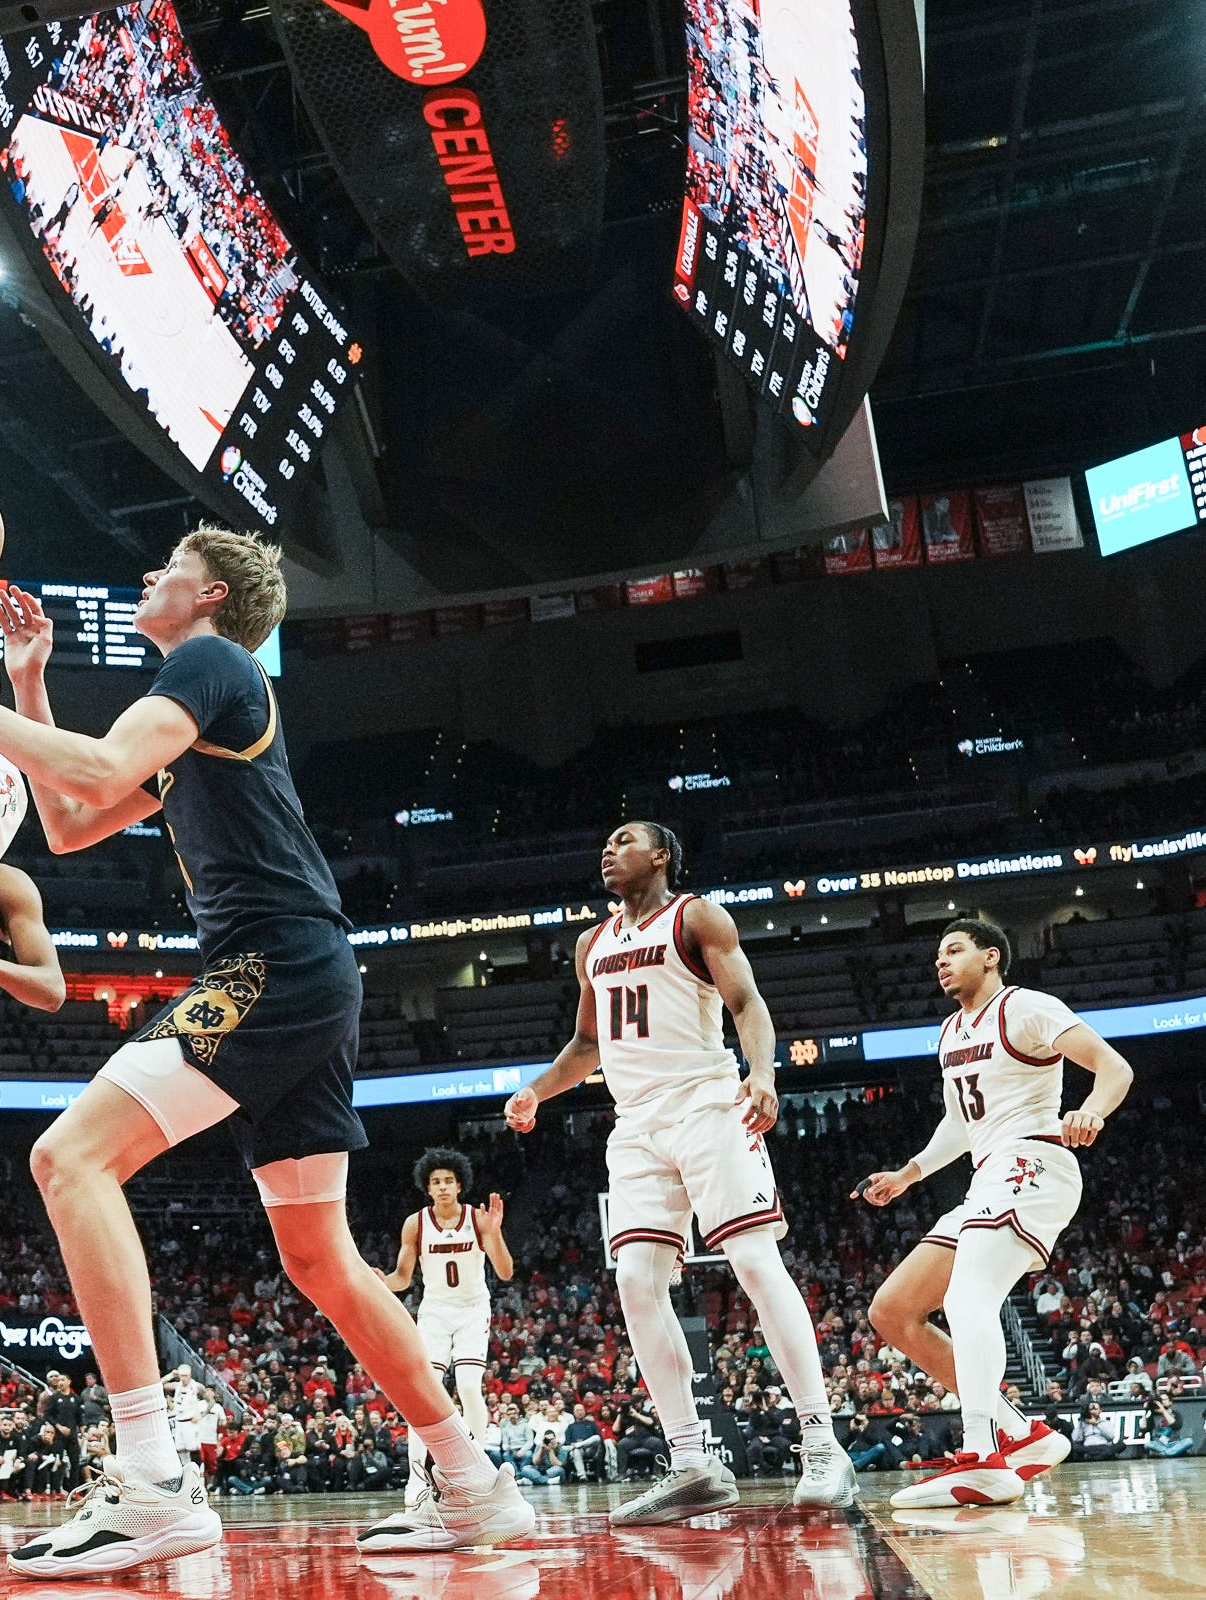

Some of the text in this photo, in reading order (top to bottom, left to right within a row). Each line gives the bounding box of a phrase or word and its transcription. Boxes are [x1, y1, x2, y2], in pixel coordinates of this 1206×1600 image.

[389, 0, 467, 78] um!
[423, 95, 516, 257] CENTER
[681, 209, 699, 276] LOUISVILLE
[300, 280, 348, 346] NOTRE DAME
[695, 290, 708, 315] PPP
[292, 312, 310, 335] PPP
[714, 311, 728, 337] EFG
[782, 313, 796, 343] 16.7
[278, 338, 296, 364] EFG
[732, 329, 746, 357] ORB
[265, 363, 284, 390] ORB
[751, 349, 765, 377] TOV
[769, 371, 784, 397] FTR
[805, 347, 831, 409] Children's
[252, 387, 272, 413] TOV
[239, 412, 258, 440] FTR
[278, 458, 295, 480] 0.0
[232, 471, 278, 525] Children's
[1099, 473, 1180, 515] UniFirst
[816, 854, 1063, 895] Over 35 Nonstop Destinations
[390, 927, 408, 940] to
[409, 913, 531, 939] Raleigh-Durham
[533, 908, 563, 925] and
[565, 905, 596, 922] L.A.
[51, 931, 98, 947] ations
[593, 944, 668, 979] LOUISVILLE
[606, 984, 649, 1041] 14
[1153, 1014, 1183, 1029] Look
[1185, 1012, 1200, 1026] for
[944, 1042, 994, 1069] LOUISVILLE
[432, 1077, 492, 1097] Look for the
[953, 1073, 986, 1123] 13
[445, 1260, 459, 1288] 0
[30, 1317, 93, 1360] Kroge
